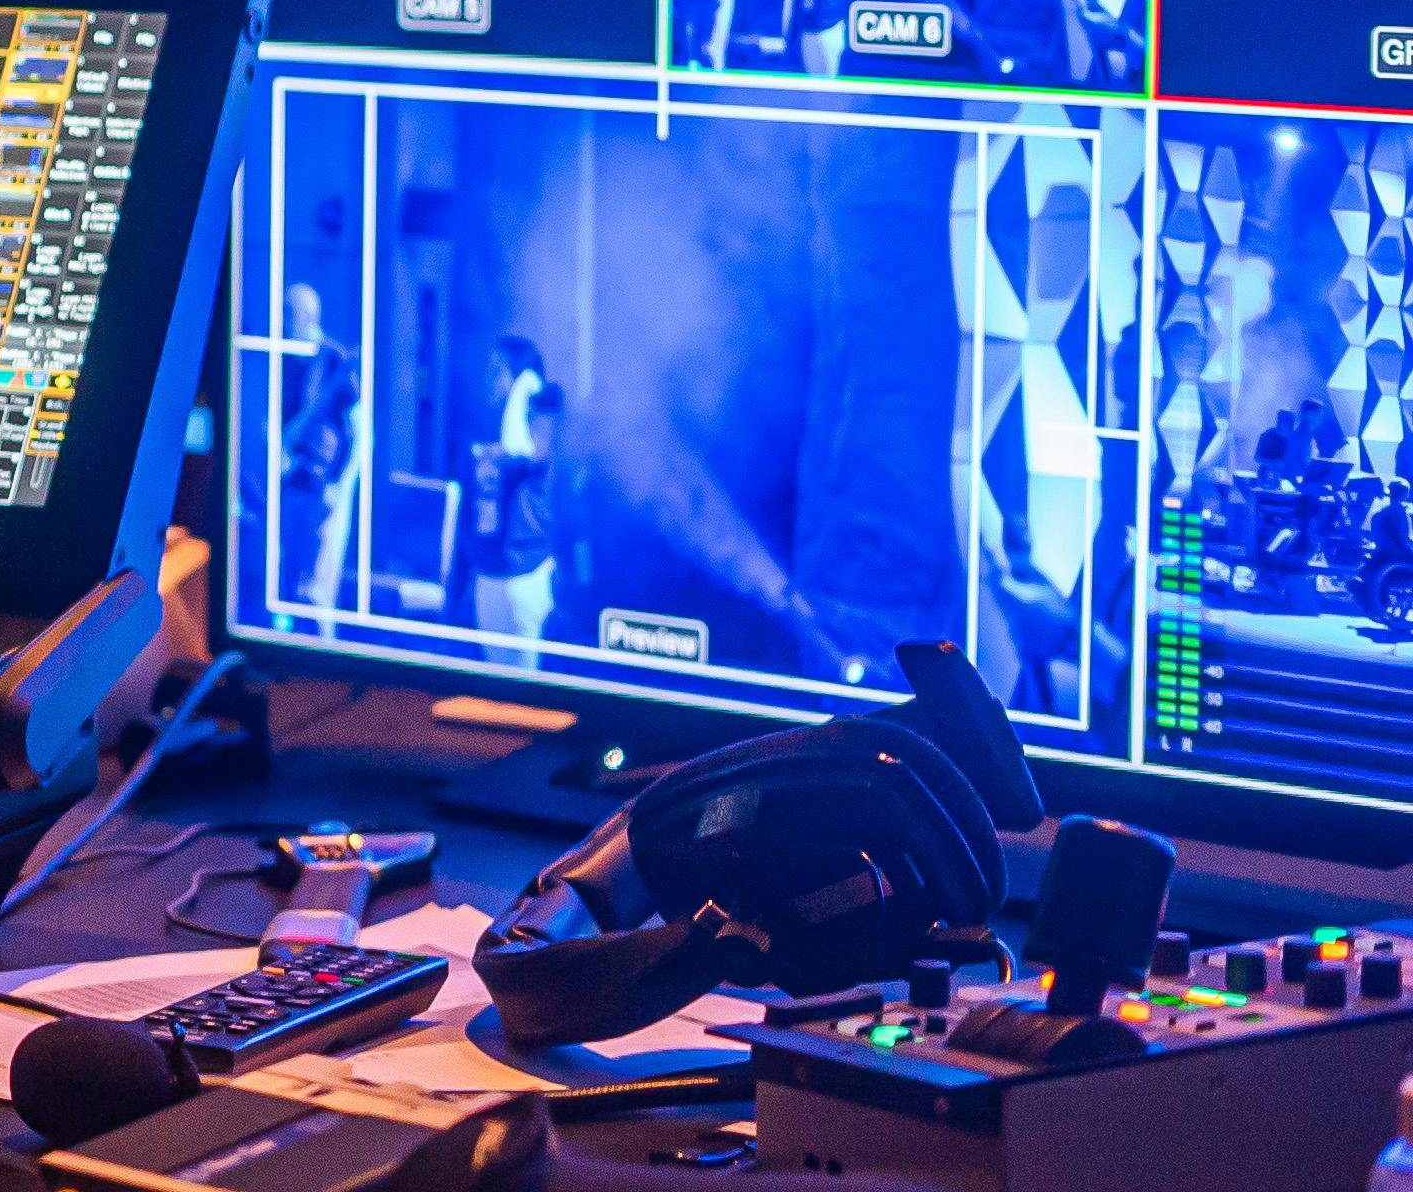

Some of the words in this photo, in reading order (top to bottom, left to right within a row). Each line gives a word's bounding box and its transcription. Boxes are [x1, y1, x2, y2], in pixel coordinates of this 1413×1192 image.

[858, 12, 918, 42] CAM
[923, 15, 942, 44] 6
[608, 619, 697, 659] Preview
